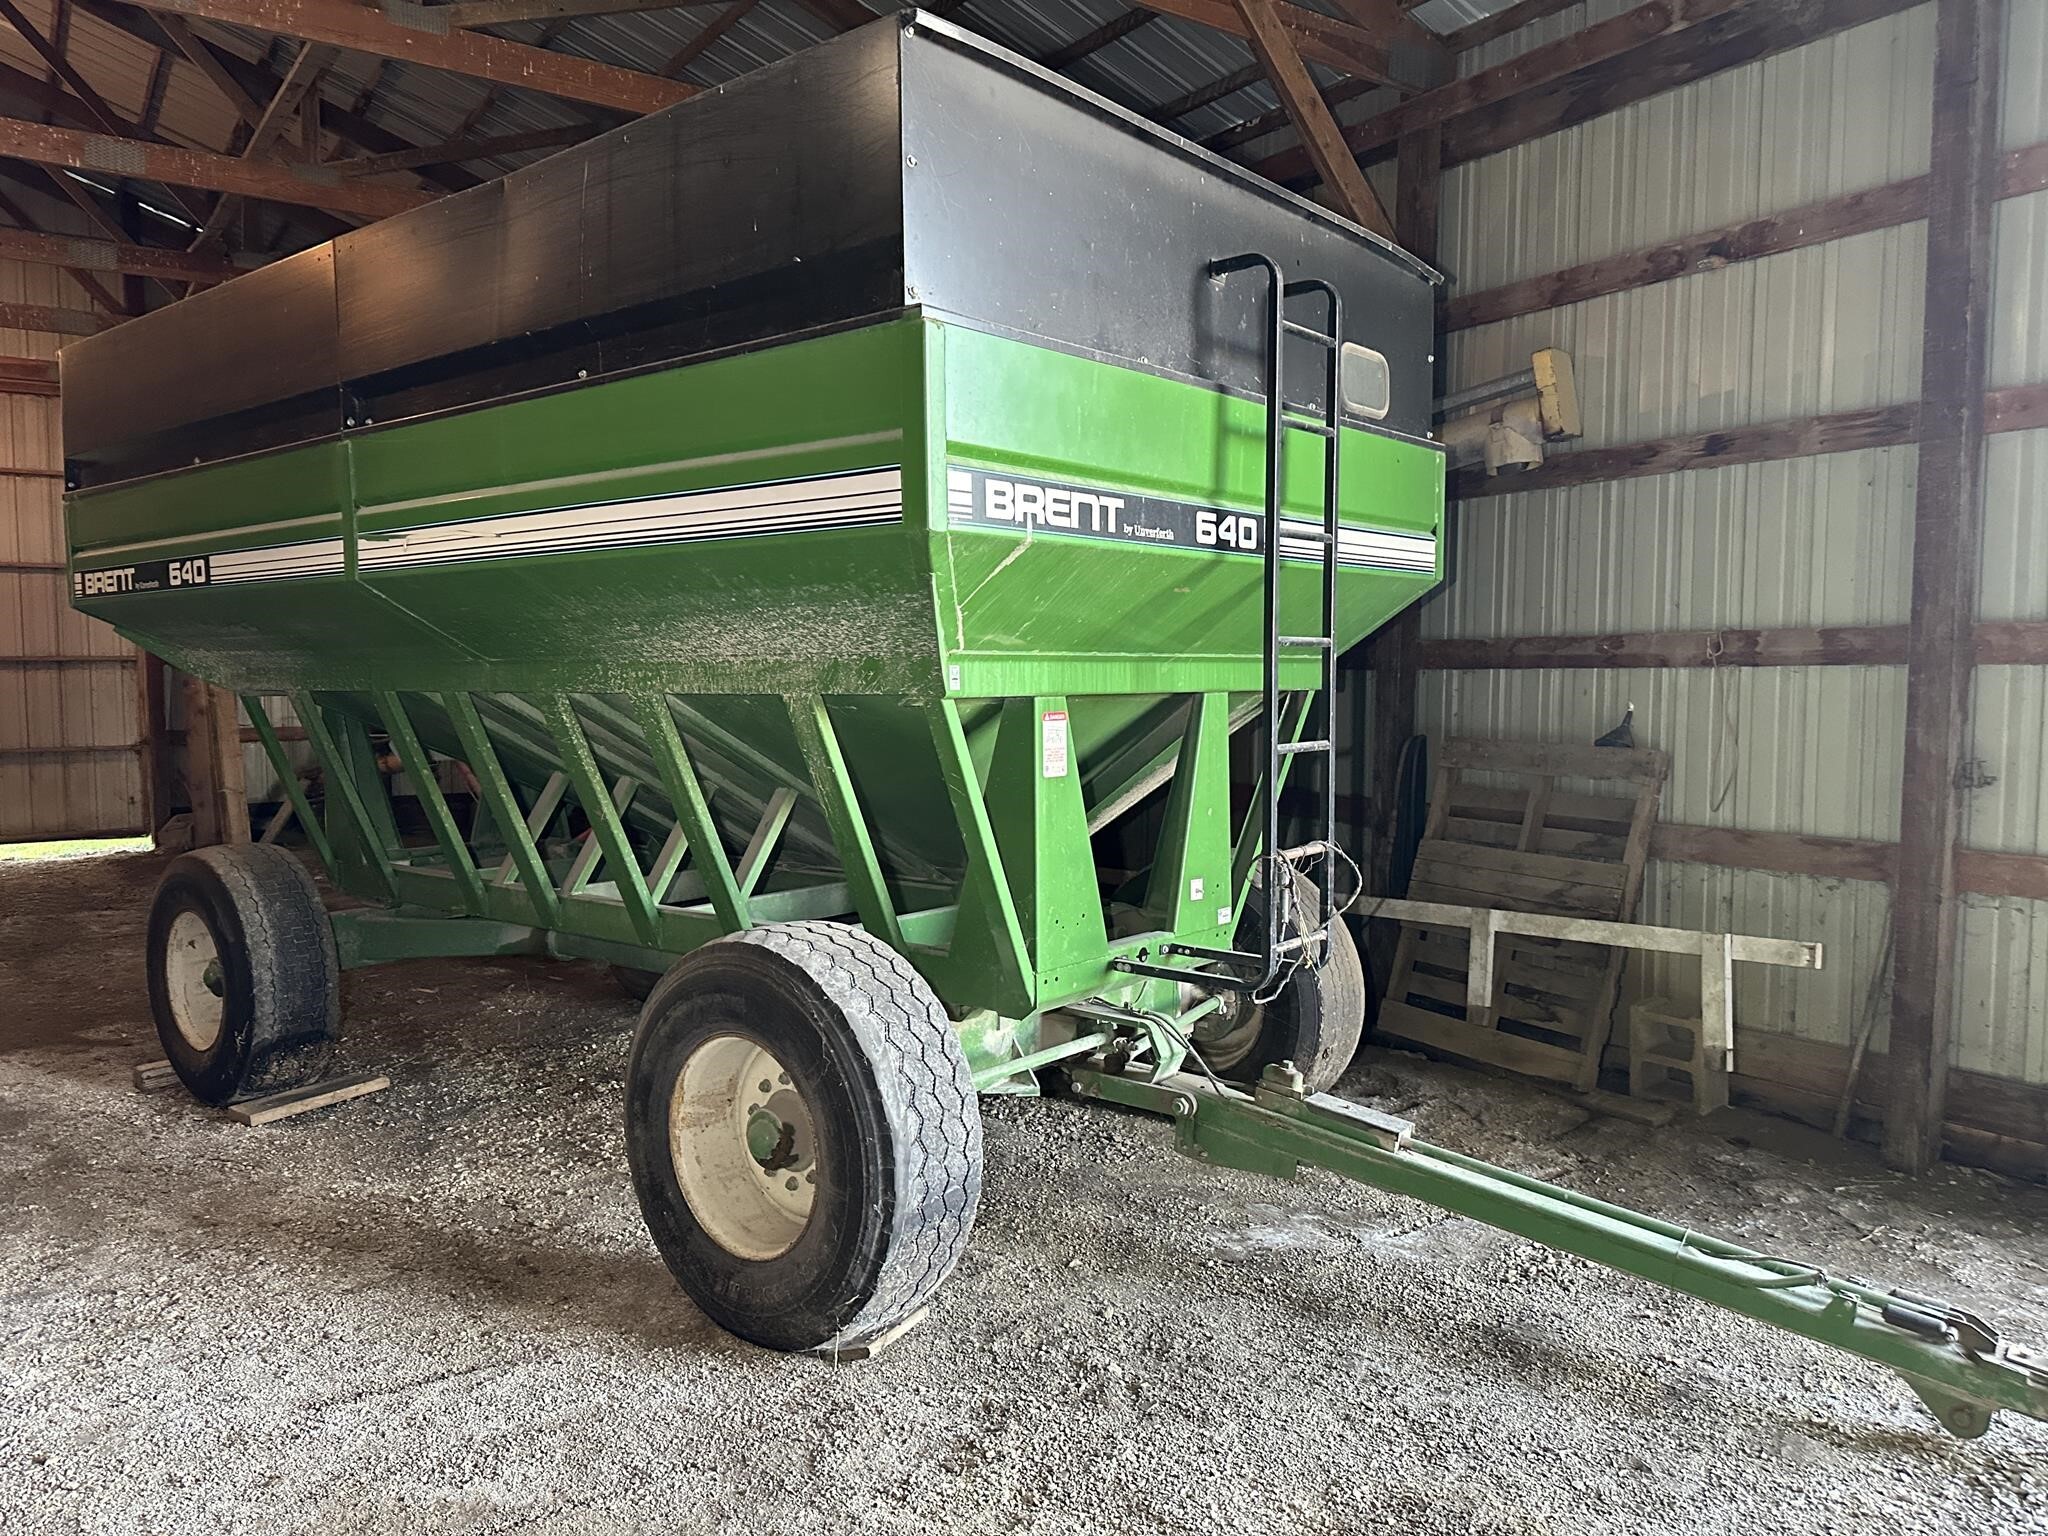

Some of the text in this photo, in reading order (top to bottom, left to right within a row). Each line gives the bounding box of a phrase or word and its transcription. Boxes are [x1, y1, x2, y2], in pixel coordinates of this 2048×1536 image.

[984, 478, 1125, 533] BRENT
[1123, 523, 1134, 537] by
[1195, 510, 1258, 550] 640
[84, 559, 206, 595] BRENT 640
